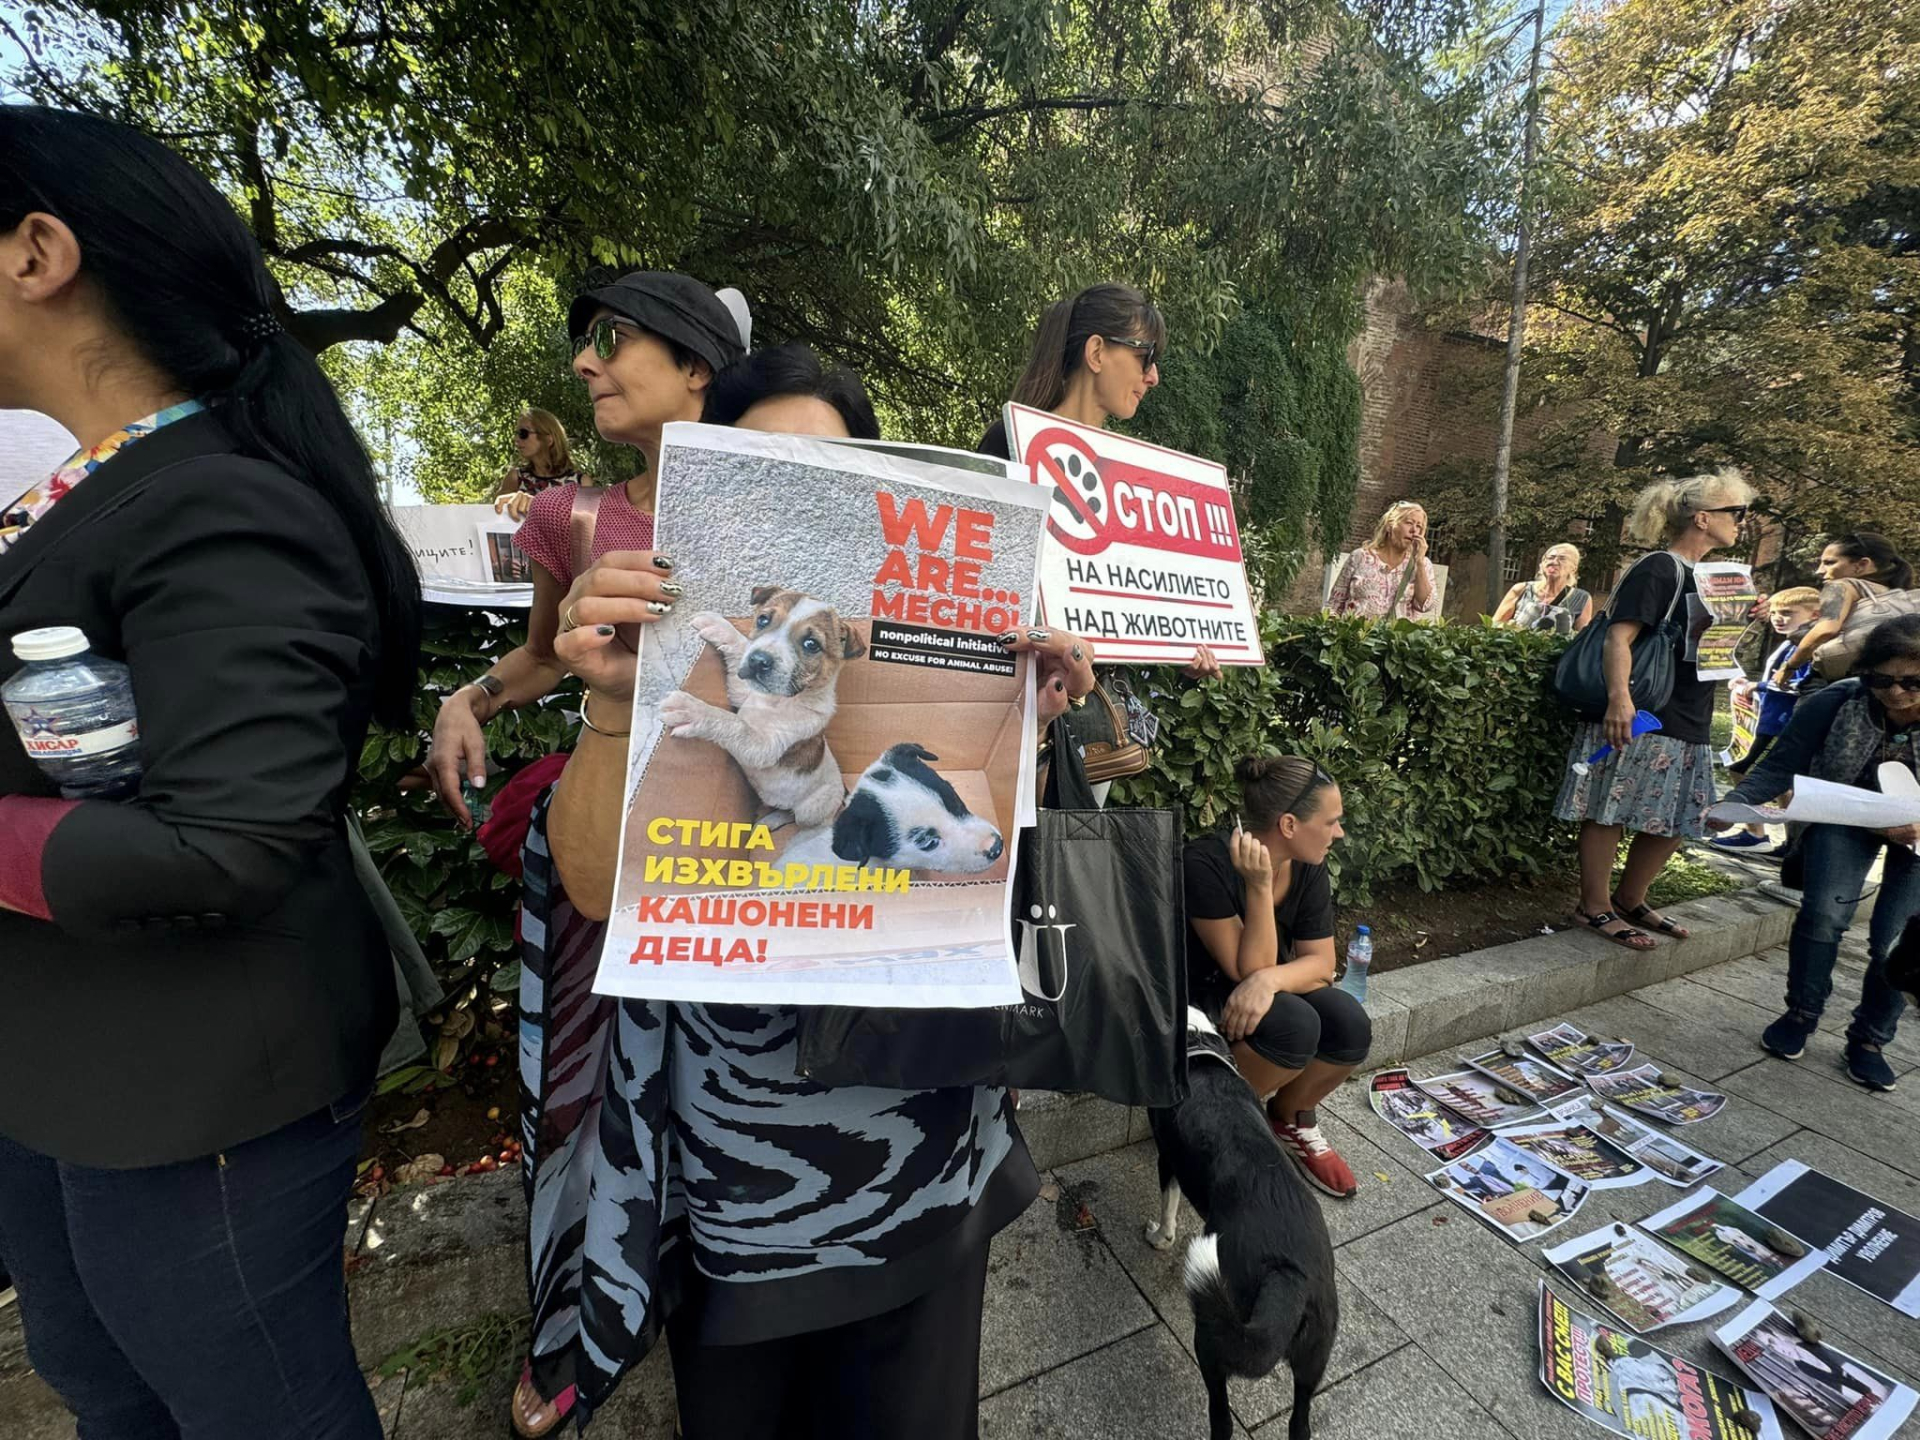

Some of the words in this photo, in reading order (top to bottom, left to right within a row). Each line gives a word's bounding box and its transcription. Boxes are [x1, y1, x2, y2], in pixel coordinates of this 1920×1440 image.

[875, 490, 996, 562] WE
[1113, 480, 1202, 541] СТОП
[1204, 501, 1234, 547] !!!
[414, 539, 473, 564] ИЦИТЕ!
[873, 550, 1020, 605] ARE...
[1066, 557, 1103, 585] НА
[1106, 563, 1231, 600] НАСИЛИЕТО
[871, 589, 1020, 634] MECHO!
[1063, 606, 1120, 639] НАД
[1120, 611, 1247, 642] ЖИВОТНИТЕ
[879, 629, 955, 649] nonpolitical
[874, 650, 890, 659] NO
[890, 652, 927, 664] EXCUSE
[927, 656, 946, 666] FOR
[946, 659, 982, 670] ANIMAL
[982, 663, 1014, 674] ABUSE!
[25, 738, 79, 751] ХИСАР
[646, 816, 775, 851] СТИГА
[643, 855, 911, 894] ИЗХВЪРЛЕНИ
[637, 896, 875, 930] КАШОНЕНИ
[629, 935, 768, 967] ДЕЦА!
[993, 1004, 1045, 1019] NMARK
[1554, 1343, 1574, 1386] ВАС
[1556, 1379, 1576, 1400] С
